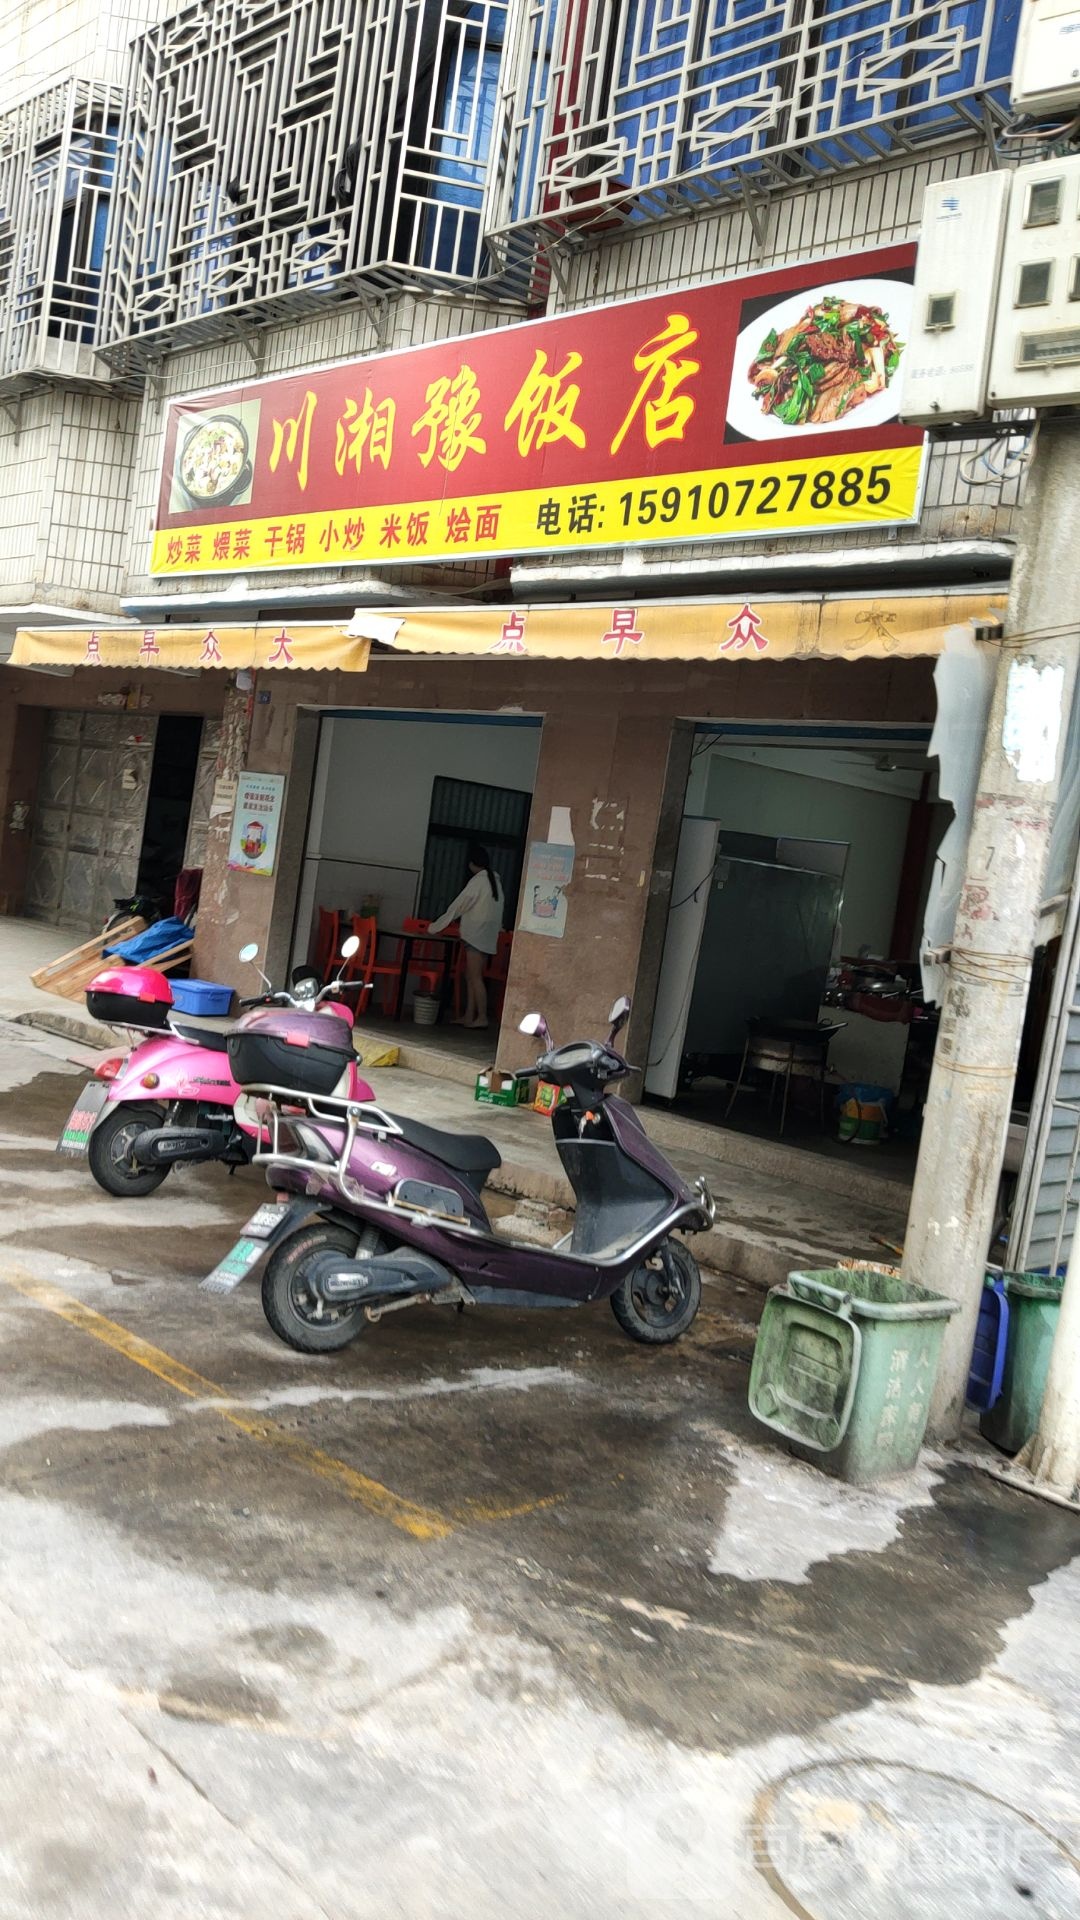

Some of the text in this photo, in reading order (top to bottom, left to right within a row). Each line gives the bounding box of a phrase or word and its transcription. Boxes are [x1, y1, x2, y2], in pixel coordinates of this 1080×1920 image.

[269, 312, 701, 491] 川湘豫饭店
[166, 504, 502, 564] 炒菜 煨菜 干锅 小炒 米饭 烩面
[537, 463, 893, 537] 电话: 15910727885
